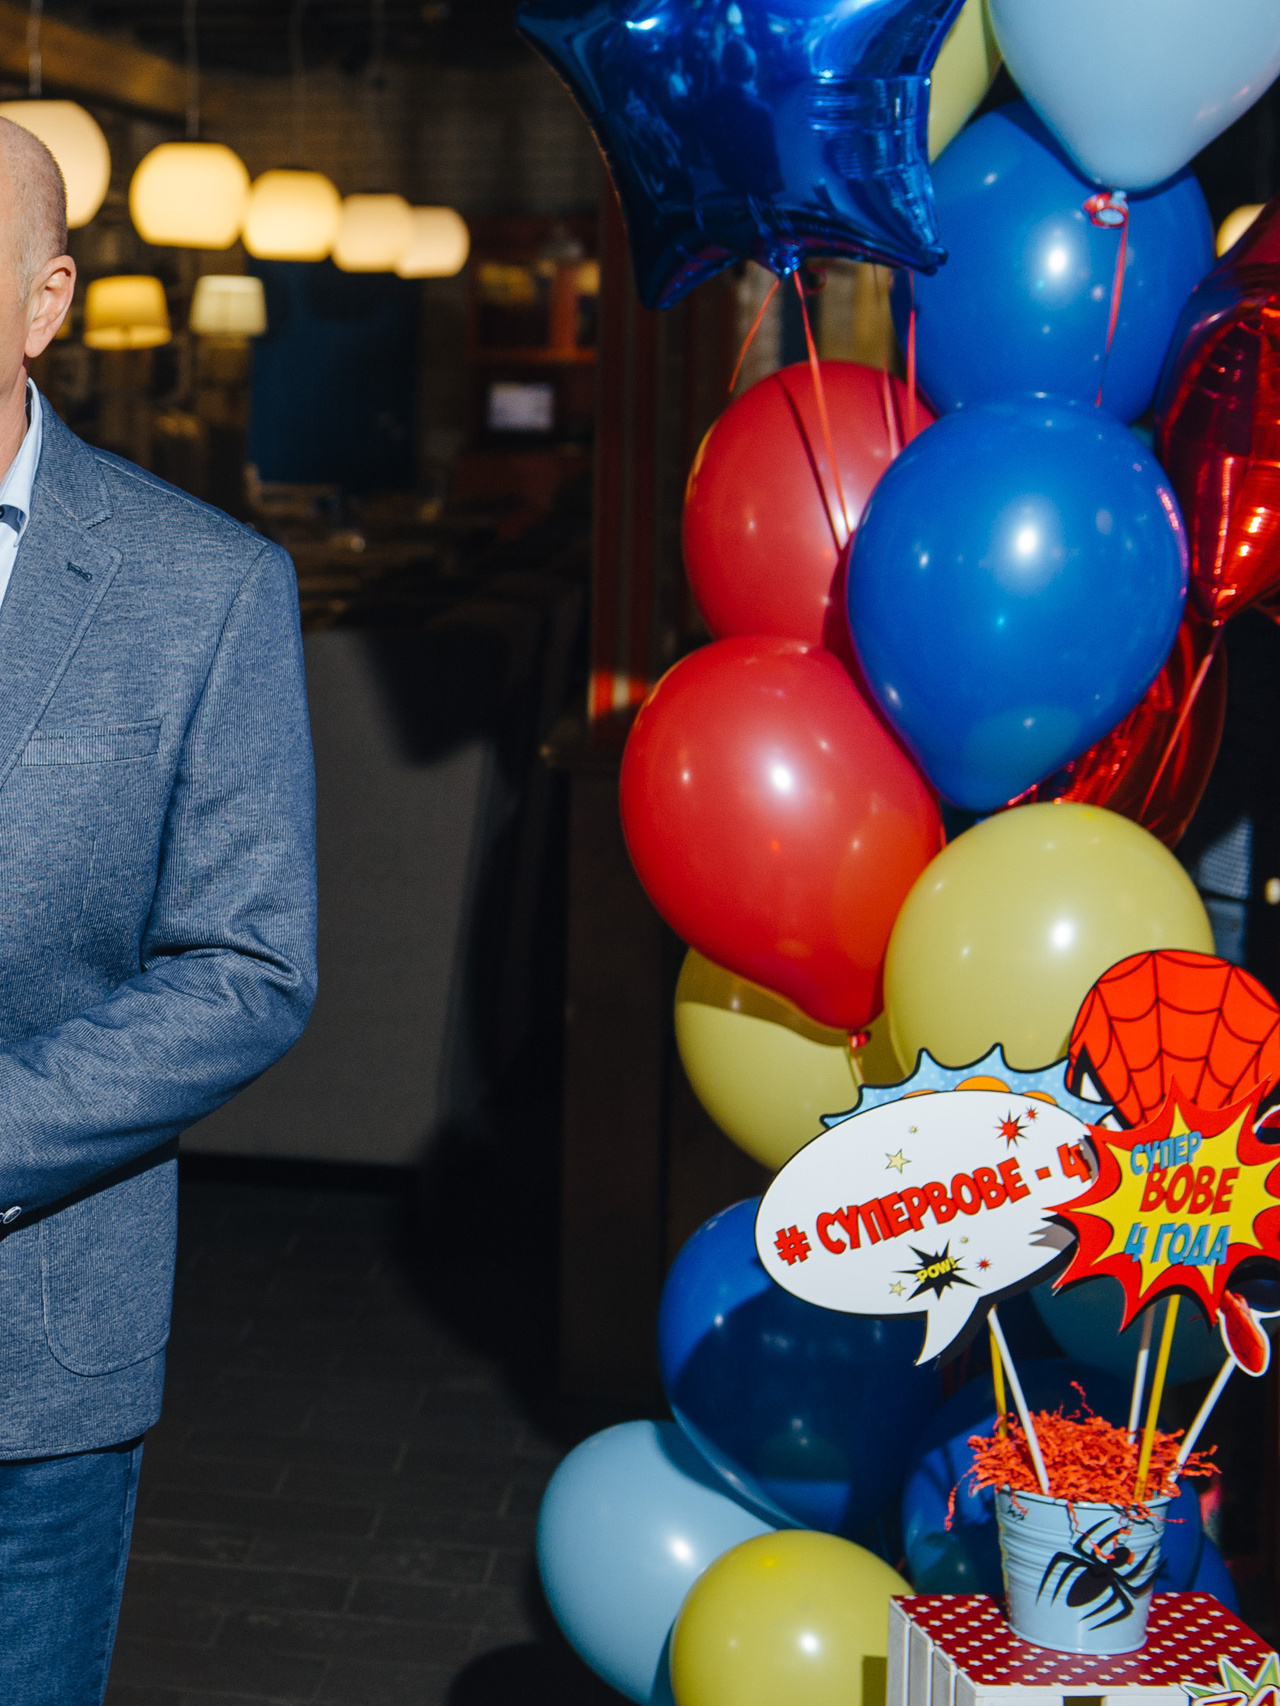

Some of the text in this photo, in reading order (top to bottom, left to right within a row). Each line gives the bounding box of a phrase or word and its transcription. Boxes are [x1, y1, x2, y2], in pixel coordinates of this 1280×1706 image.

[1130, 1131, 1202, 1175] СУПЕР
[816, 1157, 1031, 1254] СУПЕРВОВЕ
[1057, 1143, 1091, 1183] 4
[1139, 1163, 1240, 1214] ВОВЕ
[1124, 1223, 1231, 1266] 4 ГОДА
[915, 1256, 958, 1283] POW!
